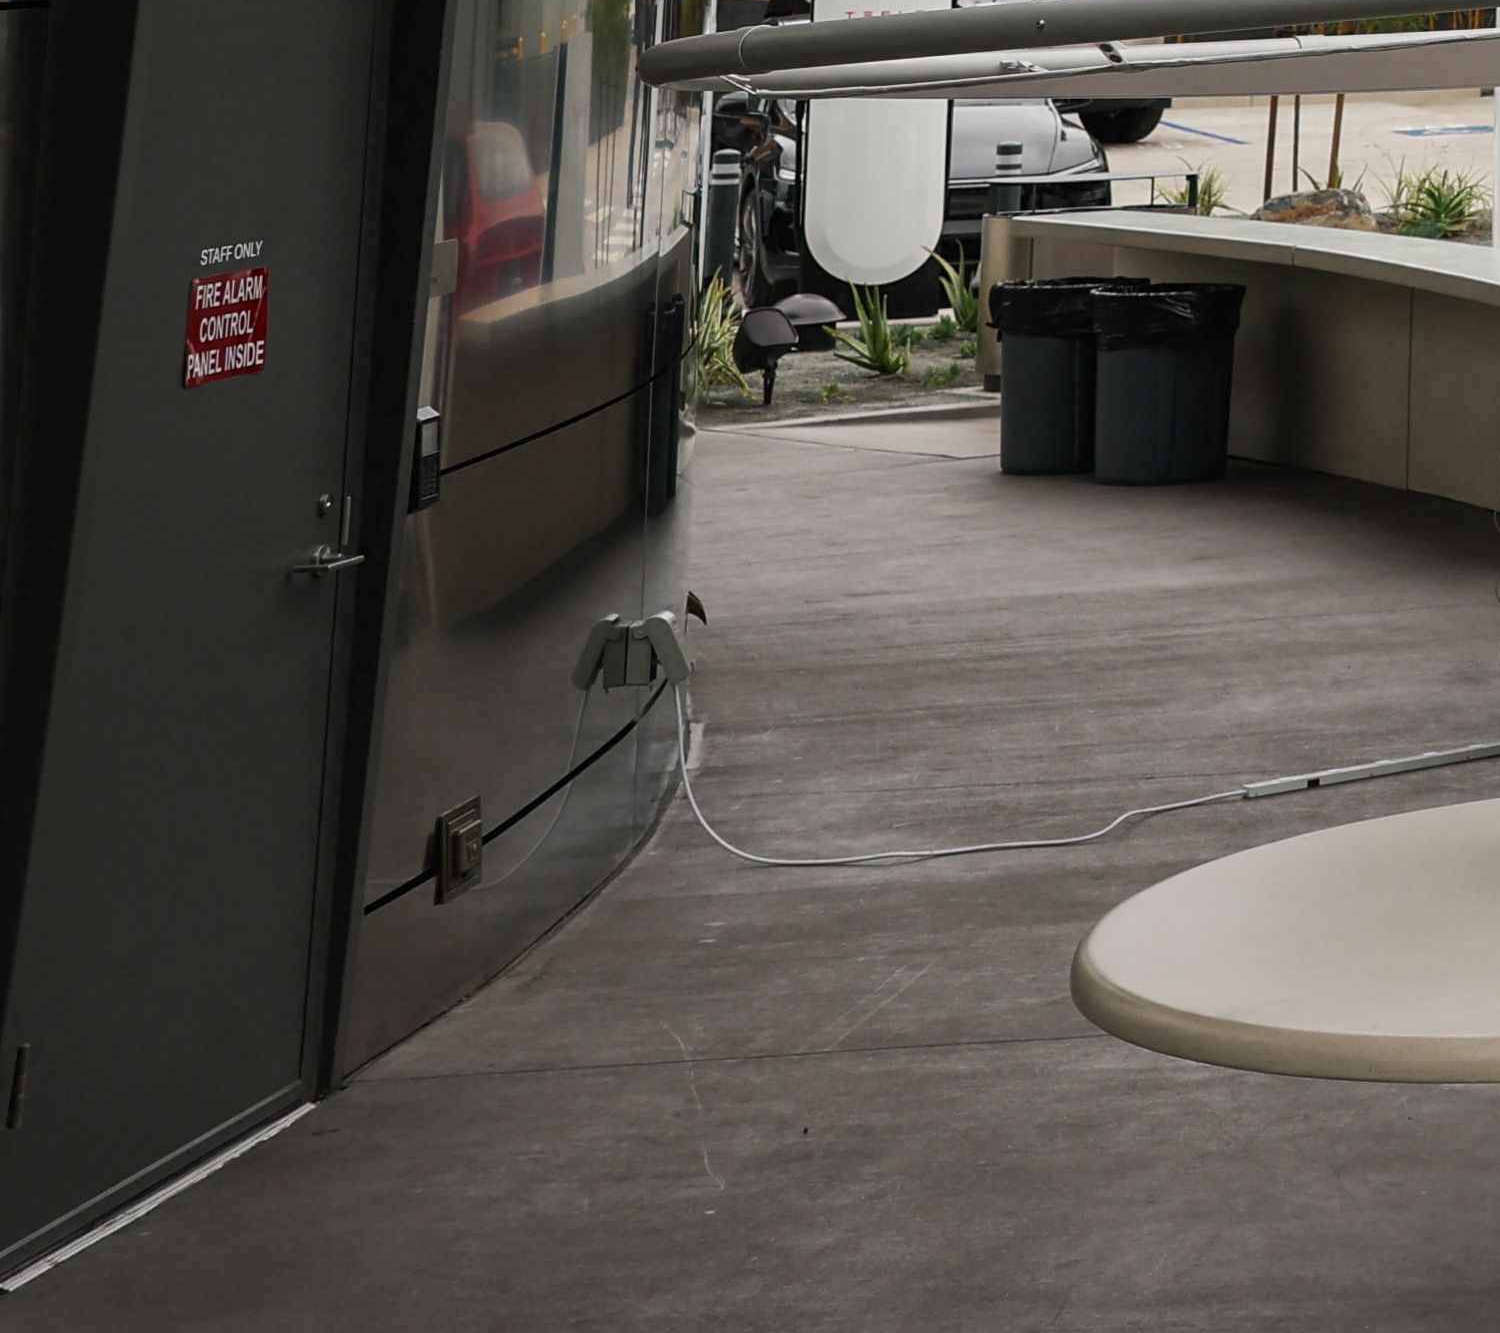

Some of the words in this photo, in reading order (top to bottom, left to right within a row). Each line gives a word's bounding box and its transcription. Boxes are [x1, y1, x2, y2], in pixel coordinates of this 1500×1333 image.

[200, 244, 234, 266] STAFF
[234, 239, 263, 261] ONLY
[195, 281, 222, 310] FIRE
[222, 275, 264, 306] ALARM
[199, 309, 255, 343] CONTROL
[186, 349, 223, 380] PANEL
[224, 340, 265, 371] INSIDE
